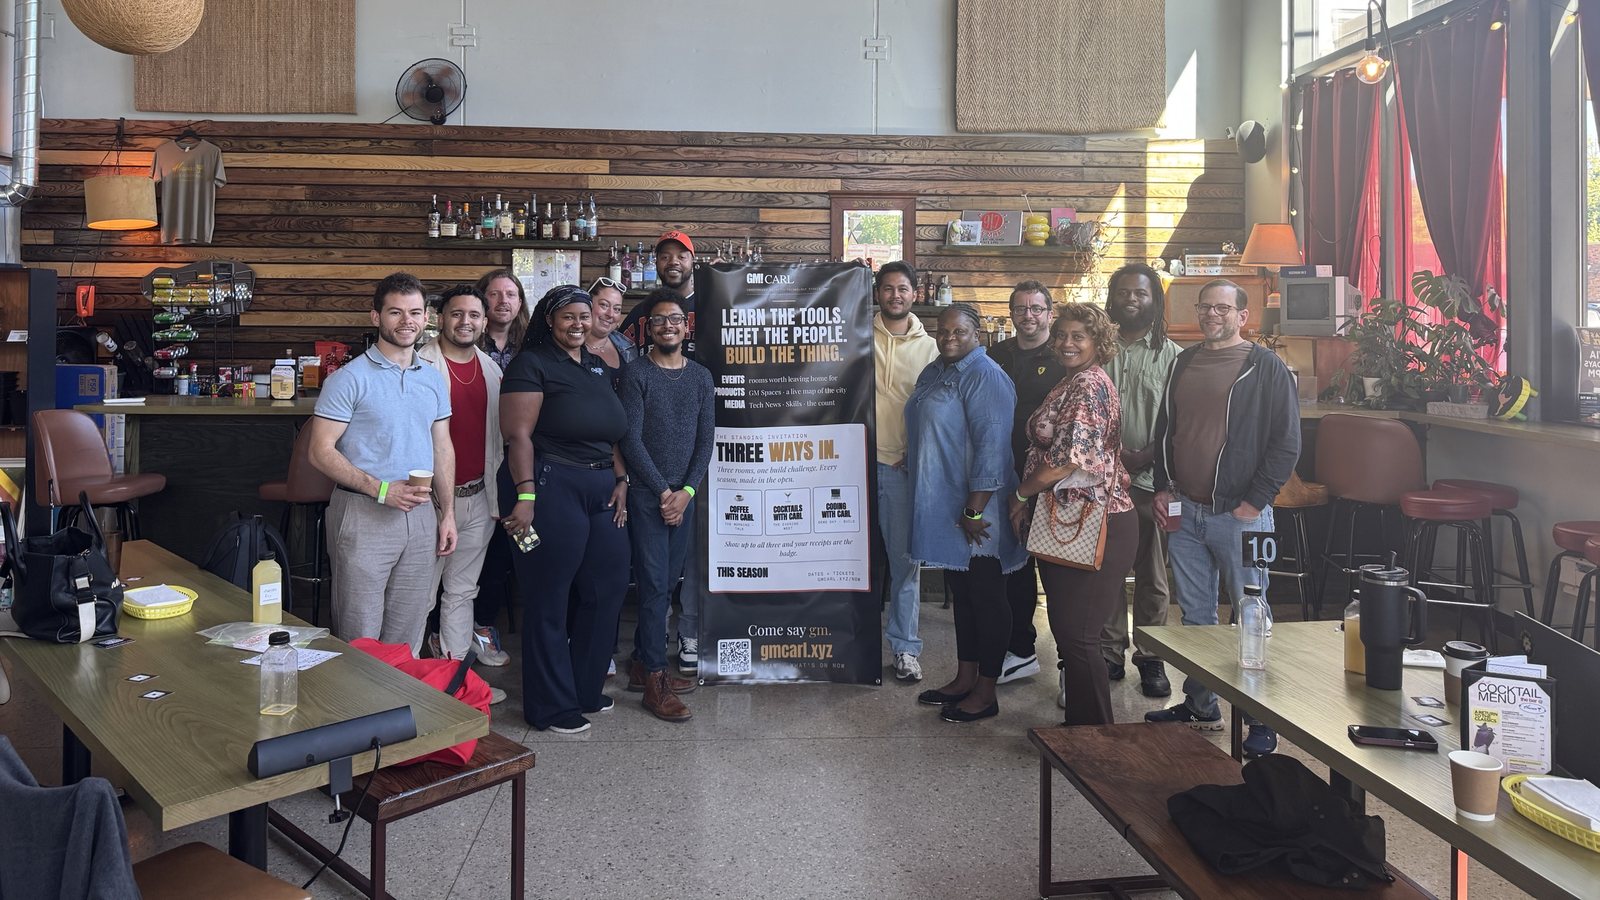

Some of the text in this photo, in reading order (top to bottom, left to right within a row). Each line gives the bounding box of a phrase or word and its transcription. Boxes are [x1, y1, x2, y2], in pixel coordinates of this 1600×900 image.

[765, 274, 794, 285] CARL
[722, 307, 845, 326] LEARN THE TOOLS.
[721, 326, 847, 346] MEET THE PEOPLE.
[726, 344, 844, 364] BUILD THE THING.
[722, 375, 745, 384] EVENTS
[714, 388, 745, 396] PRODUCTS
[725, 400, 746, 408] MEDIA
[716, 440, 839, 462] THREE WAYS IN.
[788, 465, 818, 473] challenge.
[1248, 537, 1276, 562] 10
[717, 567, 768, 578] THIS SEASON
[748, 625, 831, 638] Come say gm.
[761, 642, 832, 660] gmcarl.xyz
[1478, 683, 1541, 698] COCKTAIL
[1478, 692, 1516, 704] MENU
